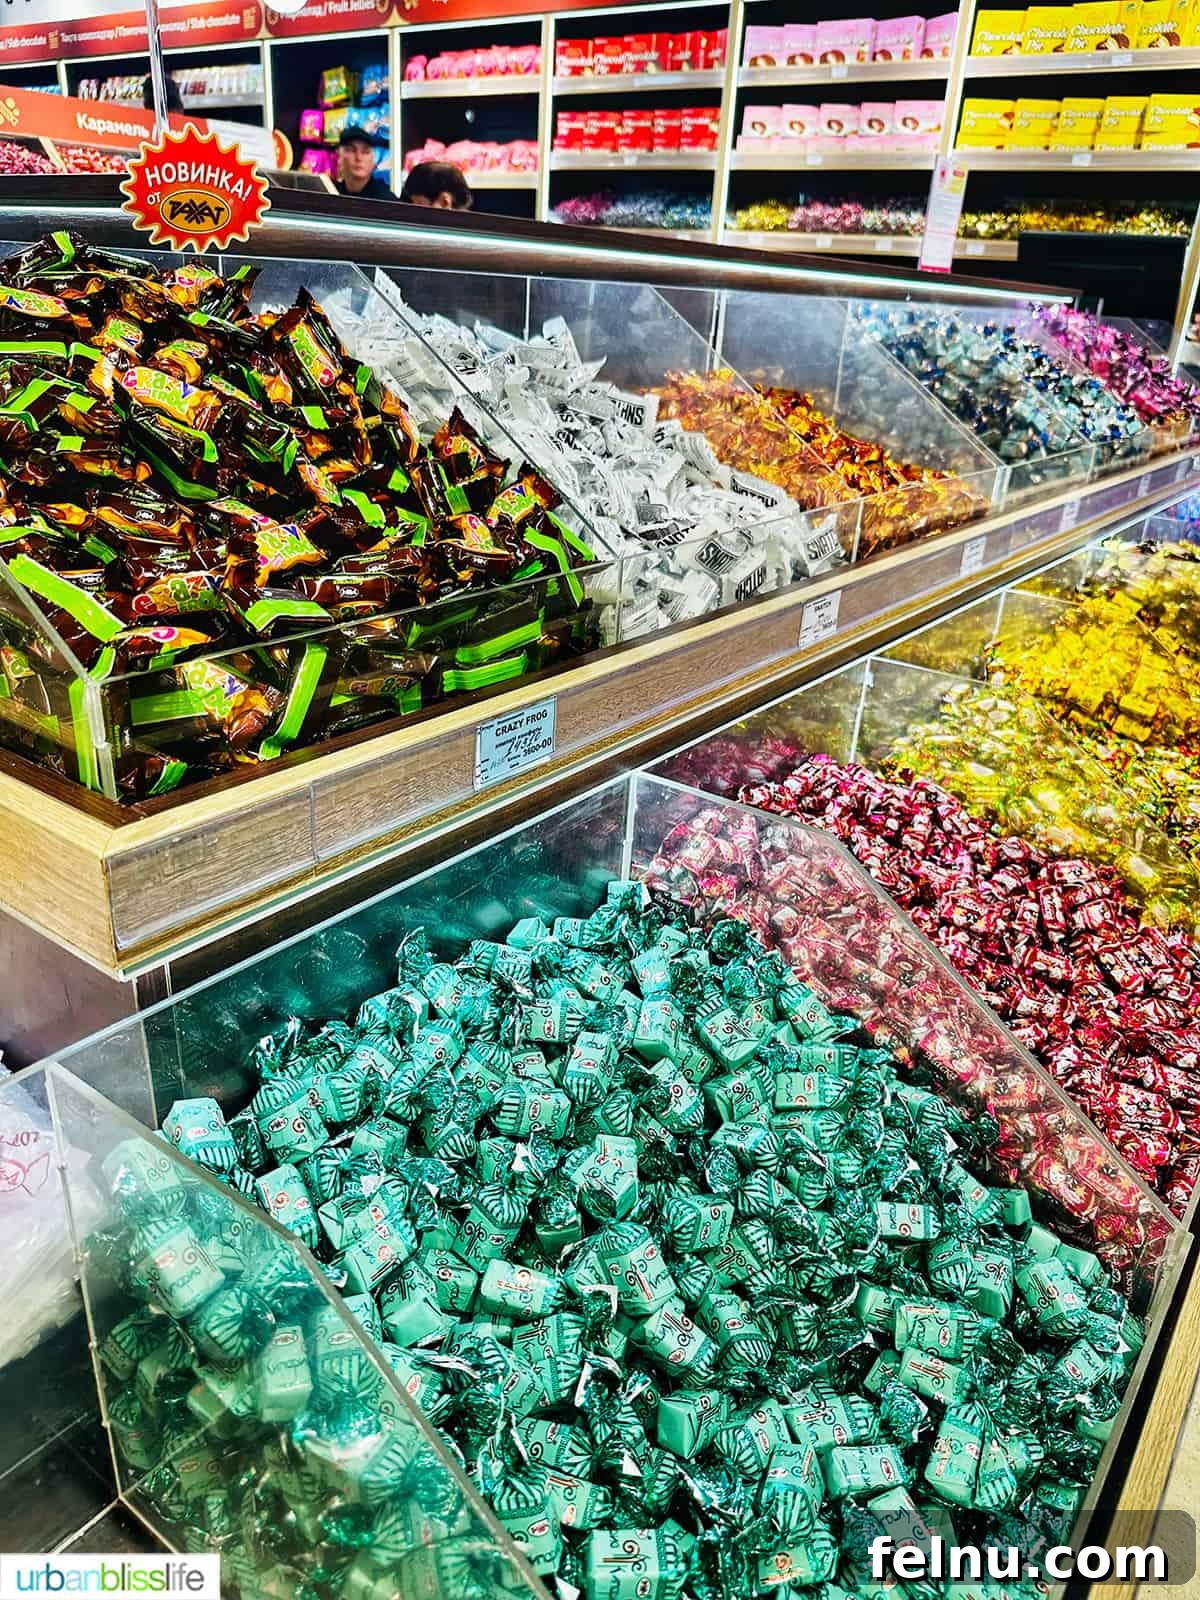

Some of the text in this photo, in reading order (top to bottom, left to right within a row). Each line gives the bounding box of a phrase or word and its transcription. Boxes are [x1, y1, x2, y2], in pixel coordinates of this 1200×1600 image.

[77, 112, 149, 138] Карамель
[145, 161, 253, 201] НОВИНКА!
[496, 709, 548, 737] CRAZY FROG
